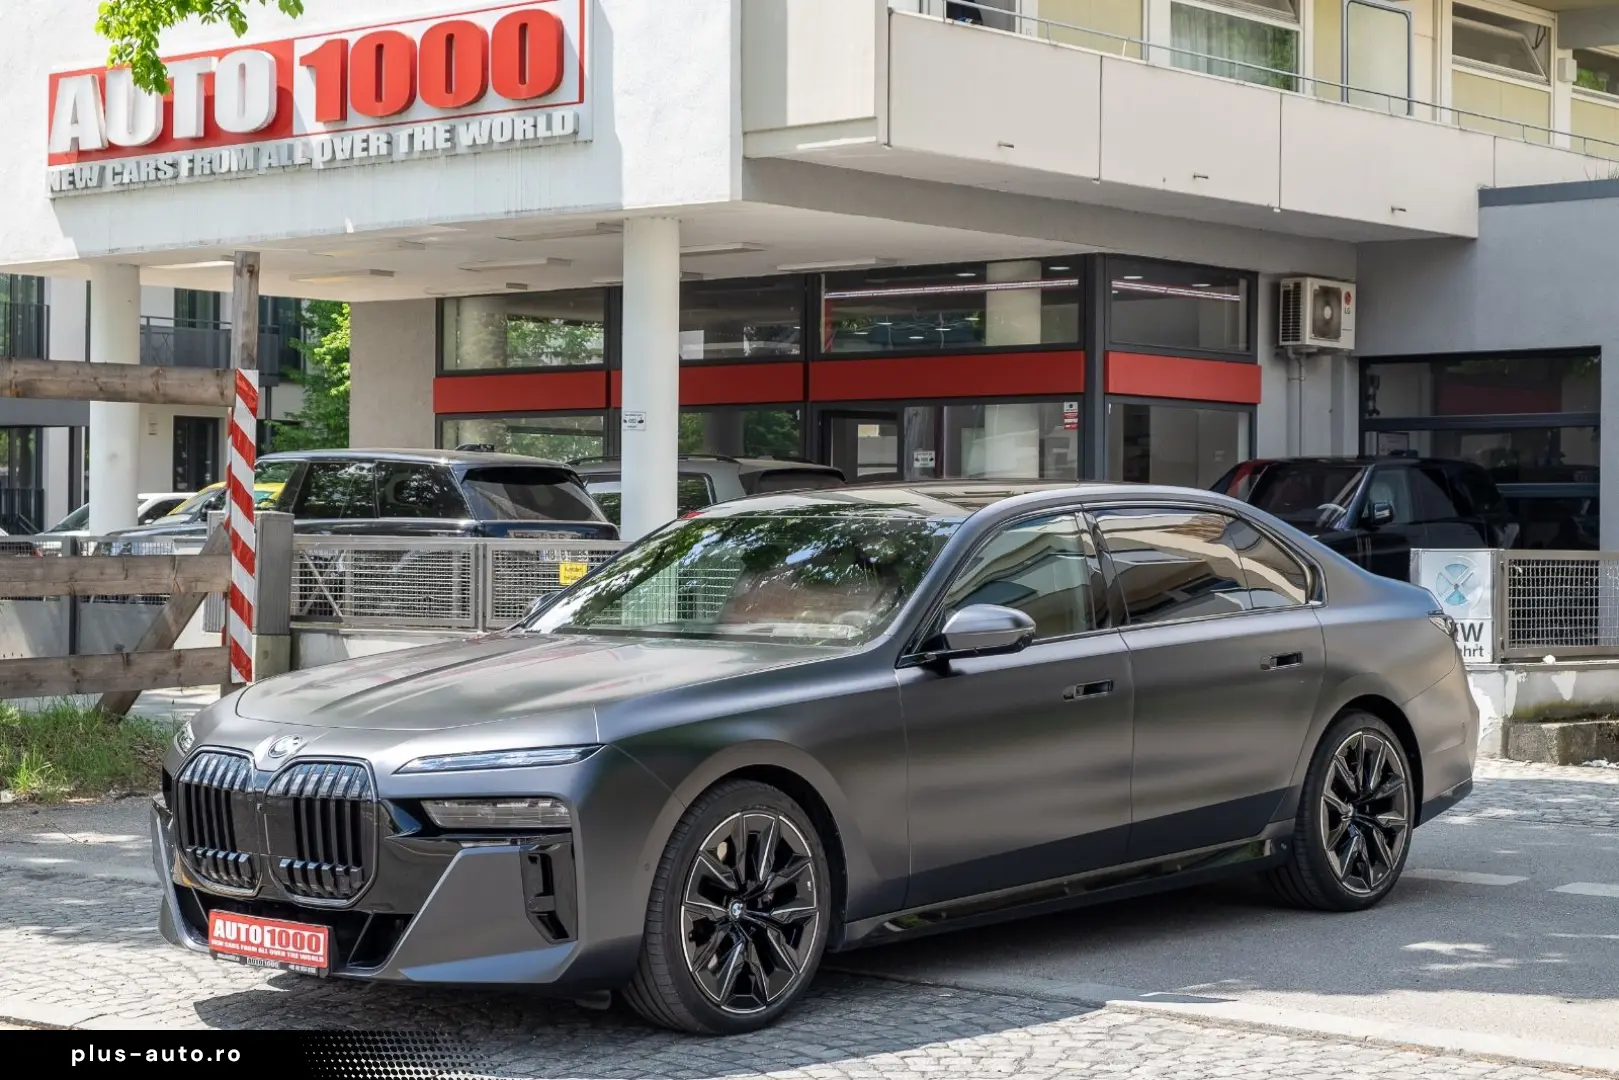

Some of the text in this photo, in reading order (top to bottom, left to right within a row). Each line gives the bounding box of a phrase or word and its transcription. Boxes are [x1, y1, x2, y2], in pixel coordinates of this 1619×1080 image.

[49, 8, 565, 153] AUTO 1000
[48, 111, 578, 192] NEW CARS FROM ALL OVER THE WORLD
[213, 918, 321, 953] AUTO 1000
[258, 947, 269, 955] ALL
